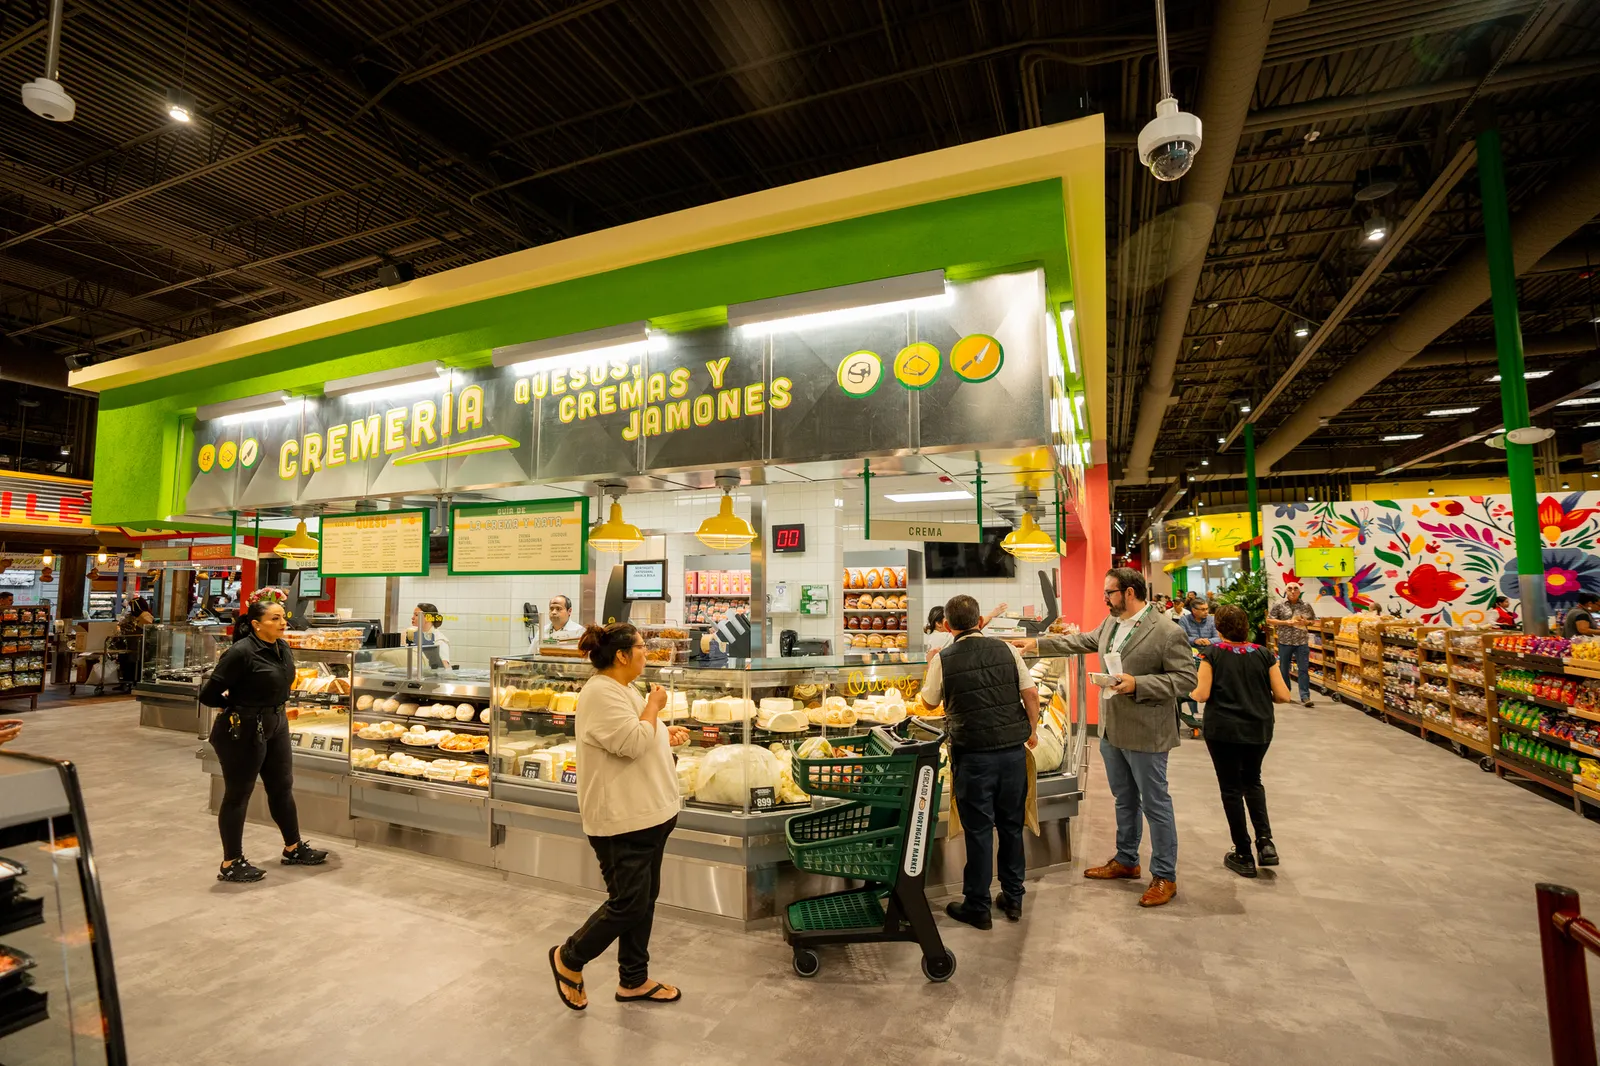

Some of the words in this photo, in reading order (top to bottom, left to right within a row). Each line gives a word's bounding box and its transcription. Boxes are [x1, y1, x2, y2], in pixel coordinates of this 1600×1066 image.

[559, 367, 692, 424] CREMAS
[705, 356, 731, 390] Y
[621, 376, 793, 442] JAMONES
[356, 516, 388, 529] QUESO
[469, 520, 481, 532] LA
[485, 517, 519, 531] CREMA
[523, 516, 529, 529] Y
[533, 516, 563, 529] NATA
[908, 526, 943, 537] CREMA
[777, 529, 800, 547] 00
[920, 768, 931, 796] MERCADO
[914, 811, 925, 846] NORTHGATE
[909, 848, 920, 874] MARKET
